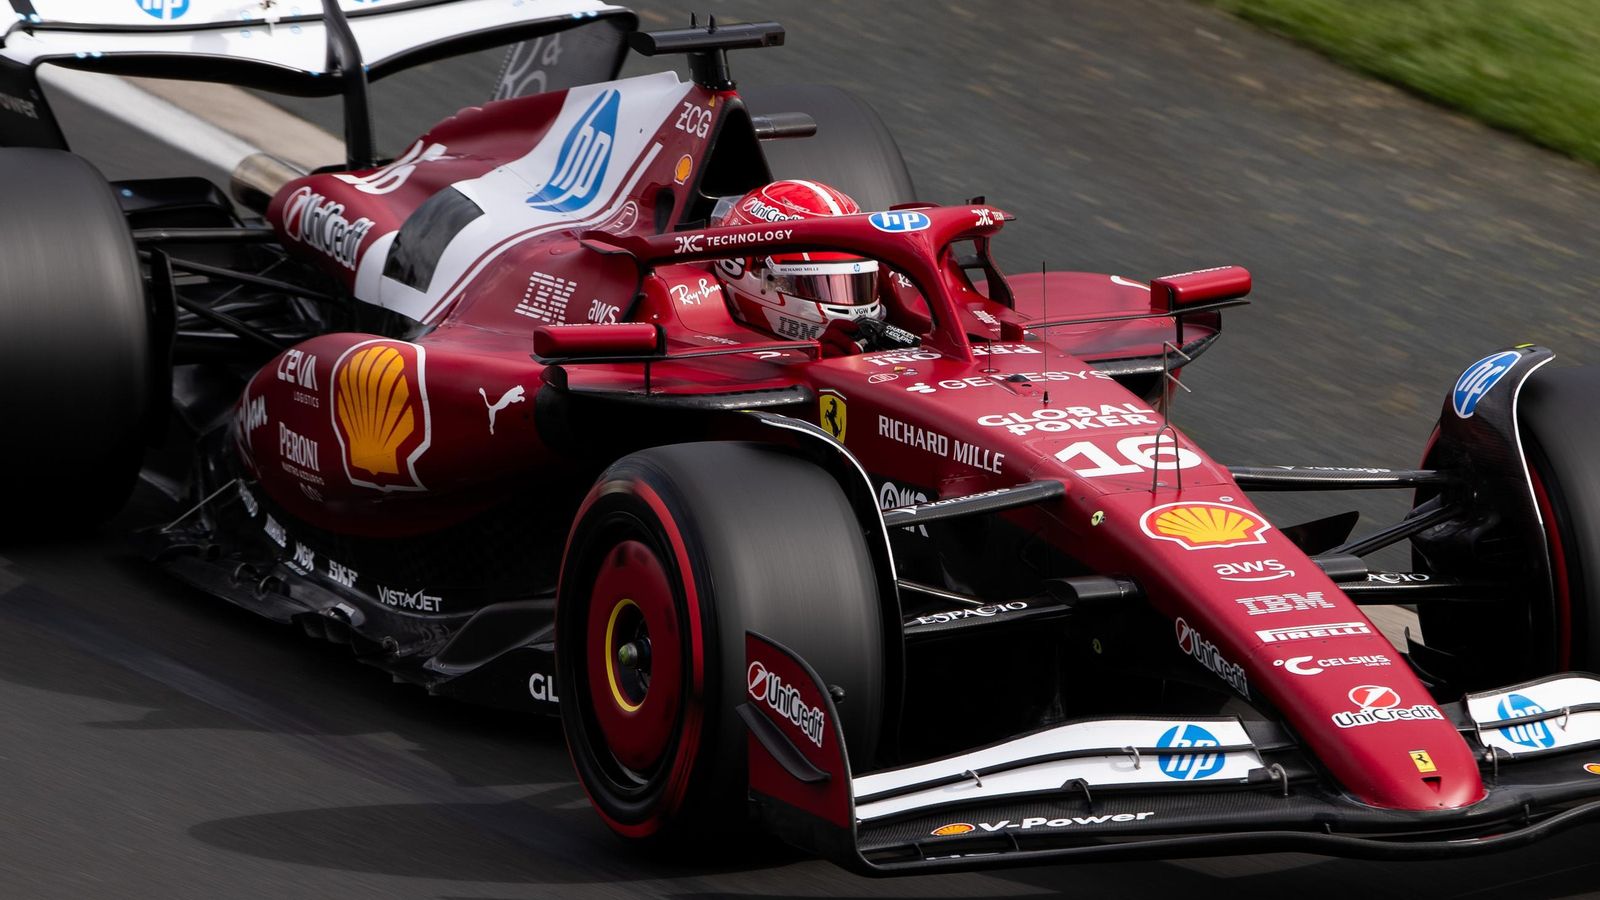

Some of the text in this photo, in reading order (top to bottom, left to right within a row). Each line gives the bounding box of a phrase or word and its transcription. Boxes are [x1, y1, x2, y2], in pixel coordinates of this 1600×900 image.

[675, 101, 713, 140] ZCG
[528, 89, 613, 206] hp
[706, 229, 793, 246] TECHNOLOGY
[514, 271, 577, 327] IBM
[670, 278, 722, 305] Ray-Ban
[587, 299, 620, 325] aws
[778, 316, 819, 340] IBM
[938, 369, 1116, 390] GENESYS
[1457, 352, 1516, 416] hp
[977, 403, 1156, 427] GLOBAL
[1006, 413, 1157, 436] POKER
[279, 421, 320, 472] PERONI
[878, 414, 1005, 475] RICHARD MILLE
[1054, 435, 1202, 478] 16
[328, 559, 357, 588] SKF
[1213, 559, 1287, 577] aws
[1367, 572, 1430, 584] ACIO
[916, 601, 1028, 625] ESPACIO
[1236, 591, 1336, 616] IBM
[1255, 621, 1372, 643] PIRELLI
[1317, 654, 1391, 667] CELSIUS
[766, 671, 825, 748] UniCredit
[1331, 704, 1445, 728] UniCredit
[1167, 725, 1218, 779] hp
[979, 810, 1155, 832] V-Power
